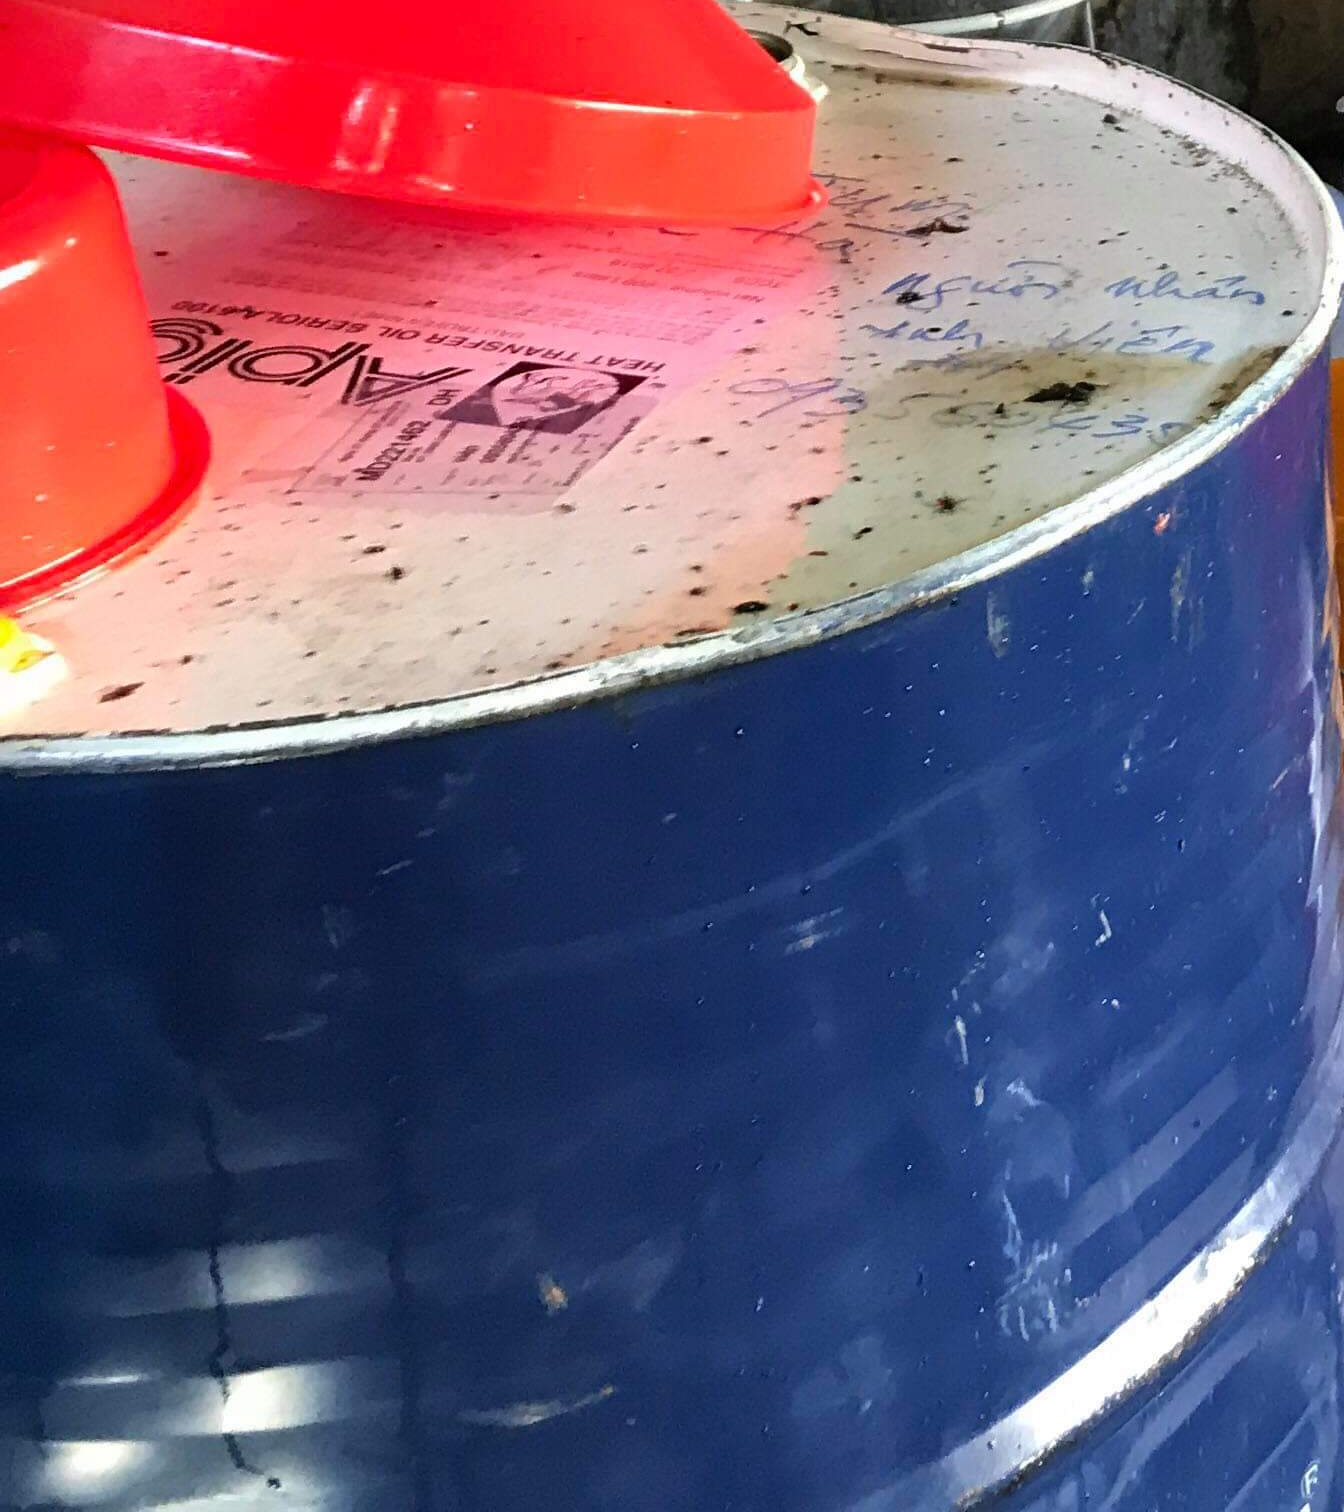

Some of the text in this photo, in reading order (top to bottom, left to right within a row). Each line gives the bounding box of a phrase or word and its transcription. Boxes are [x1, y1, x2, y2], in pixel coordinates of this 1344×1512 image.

[236, 307, 367, 334] SERIOLA
[374, 327, 423, 342] OIL
[425, 332, 583, 363] TRANSFER
[583, 354, 667, 373] HEAT
